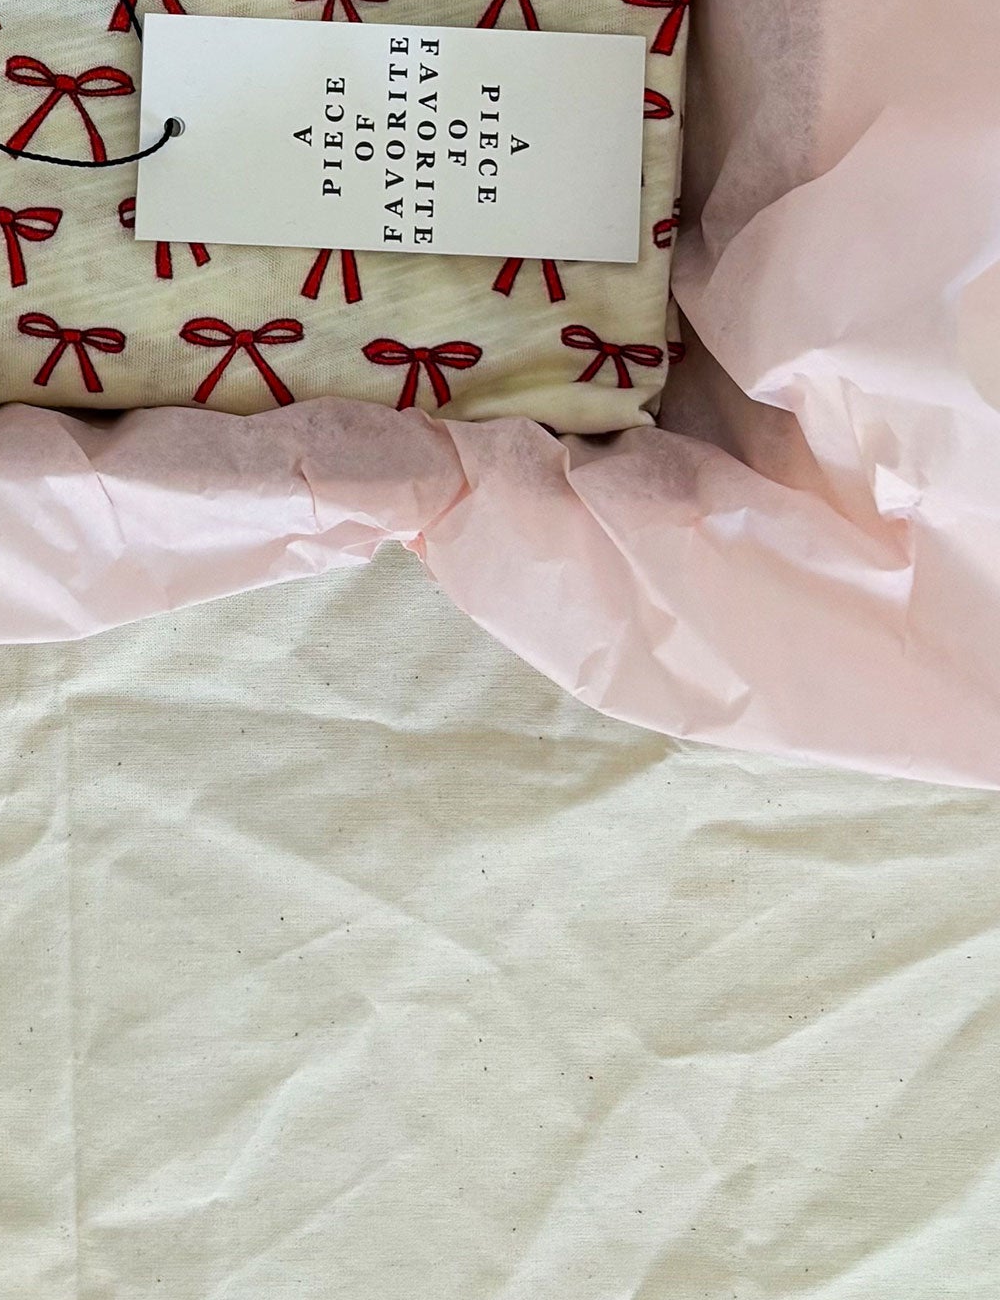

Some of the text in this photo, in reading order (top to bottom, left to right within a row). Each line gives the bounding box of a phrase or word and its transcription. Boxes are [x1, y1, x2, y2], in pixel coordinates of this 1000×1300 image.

[292, 125, 313, 147] A
[322, 77, 346, 197] PIECE
[354, 114, 375, 162] OF
[383, 37, 409, 243] FAVORITE
[413, 38, 440, 245] FAVORITE
[447, 119, 468, 167] OF
[477, 84, 501, 204] PIECE
[510, 134, 530, 156] A
